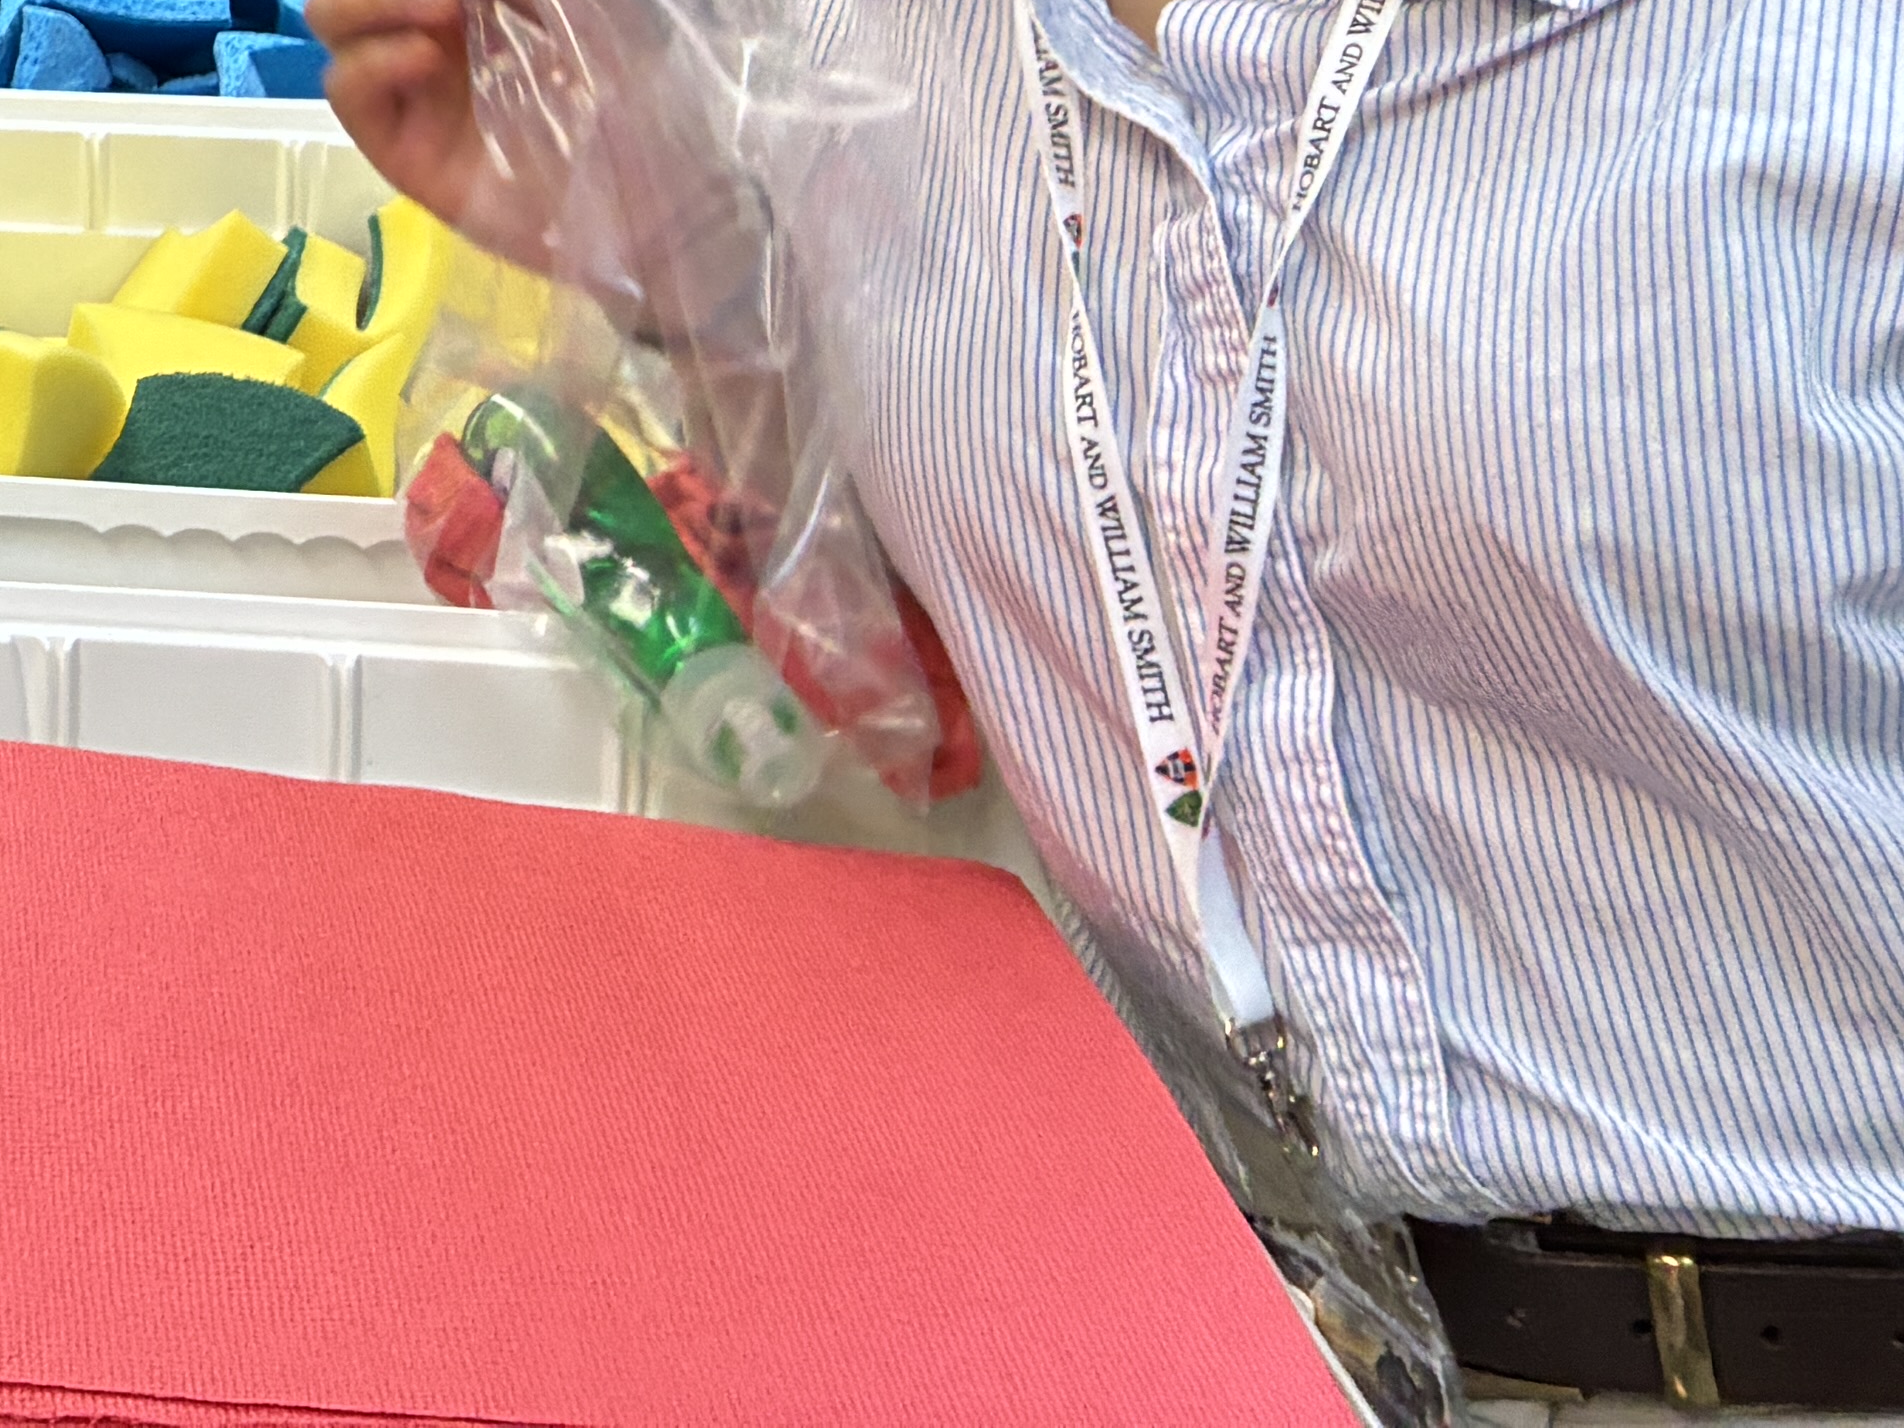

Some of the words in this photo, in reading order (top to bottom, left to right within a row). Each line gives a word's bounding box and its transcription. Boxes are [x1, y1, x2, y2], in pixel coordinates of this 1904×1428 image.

[1045, 102, 1076, 189] SMITH
[1292, 96, 1340, 212] HOBART
[1331, 42, 1364, 95] AND
[1249, 335, 1278, 427] SMITH
[1224, 431, 1269, 557] WILLIAM
[1081, 435, 1109, 490] AND
[1095, 494, 1148, 623] WILLIAM
[1128, 627, 1174, 724] SMITH
[1224, 561, 1247, 618] AND
